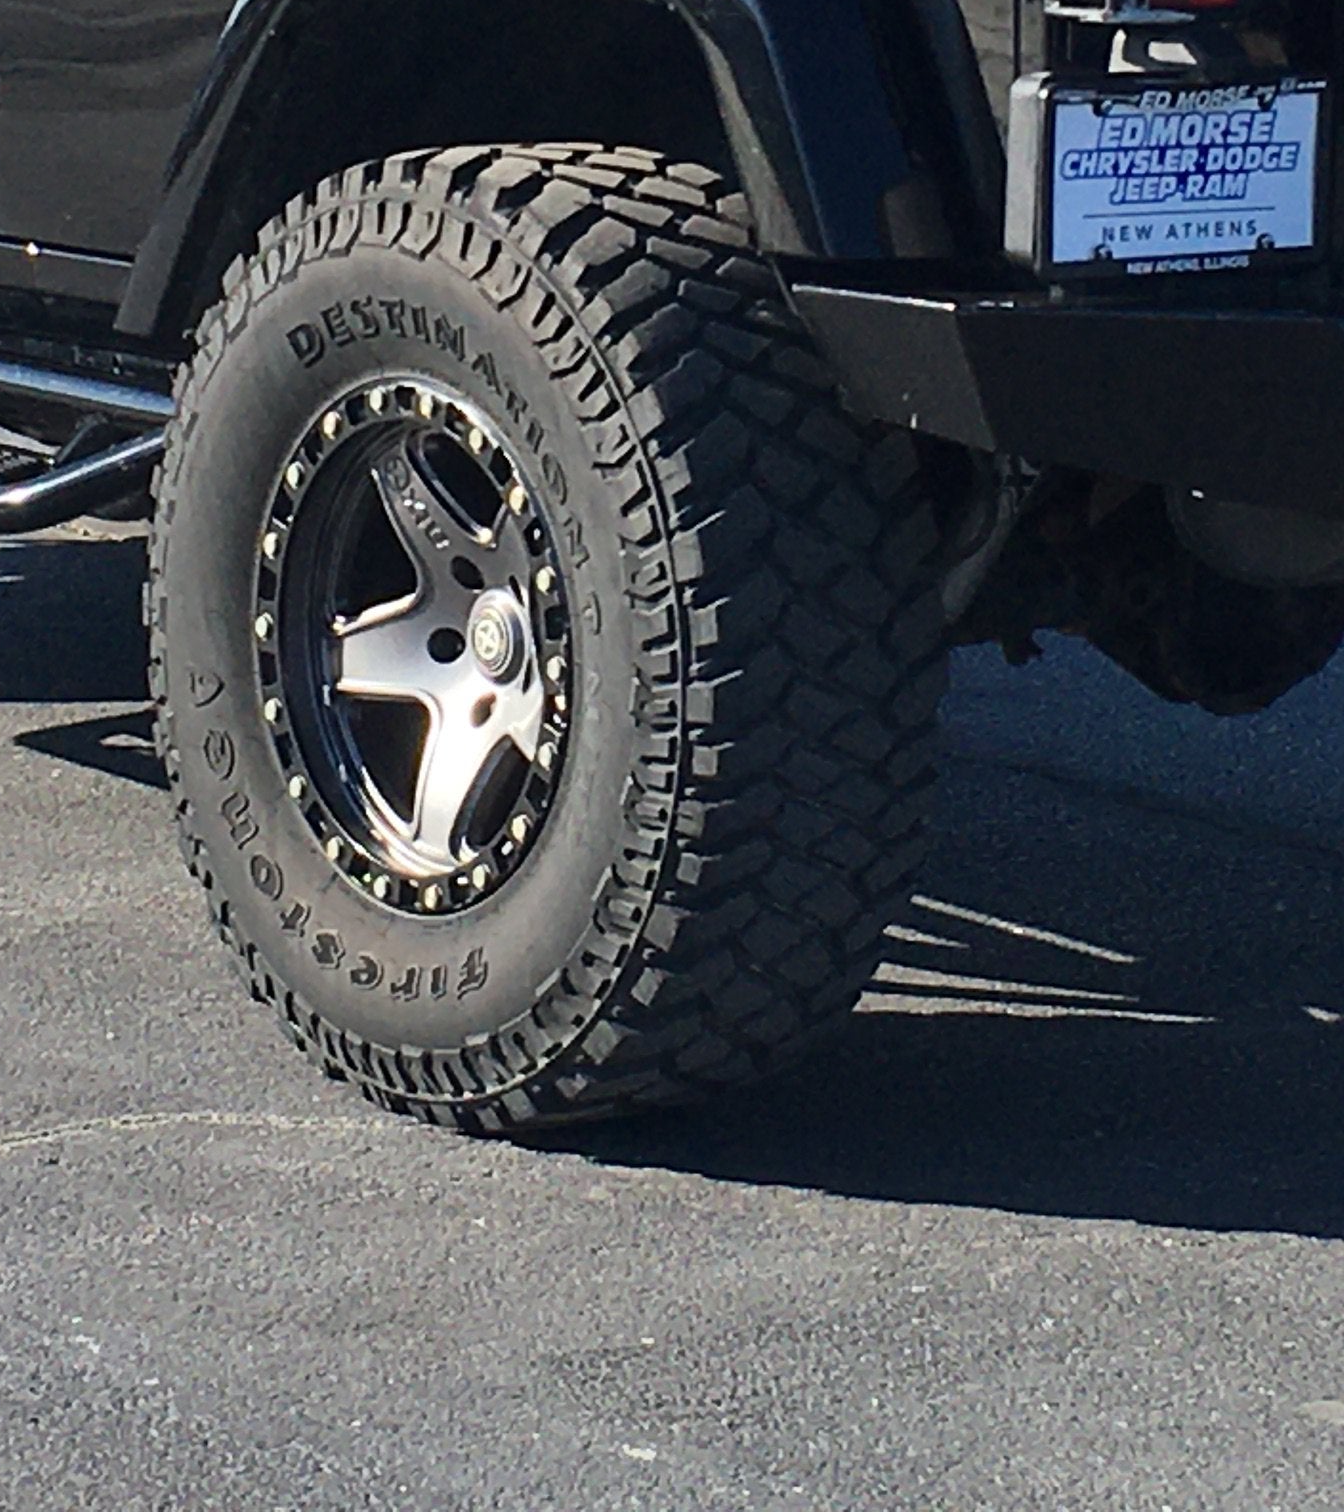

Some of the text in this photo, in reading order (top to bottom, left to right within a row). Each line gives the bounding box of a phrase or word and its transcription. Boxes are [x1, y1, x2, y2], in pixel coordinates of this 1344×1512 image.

[1098, 111, 1275, 149] ED MORSE
[1102, 219, 1259, 244] NEW ATHENS
[285, 294, 589, 571] DESTINATION
[203, 729, 490, 1000] Firestone
